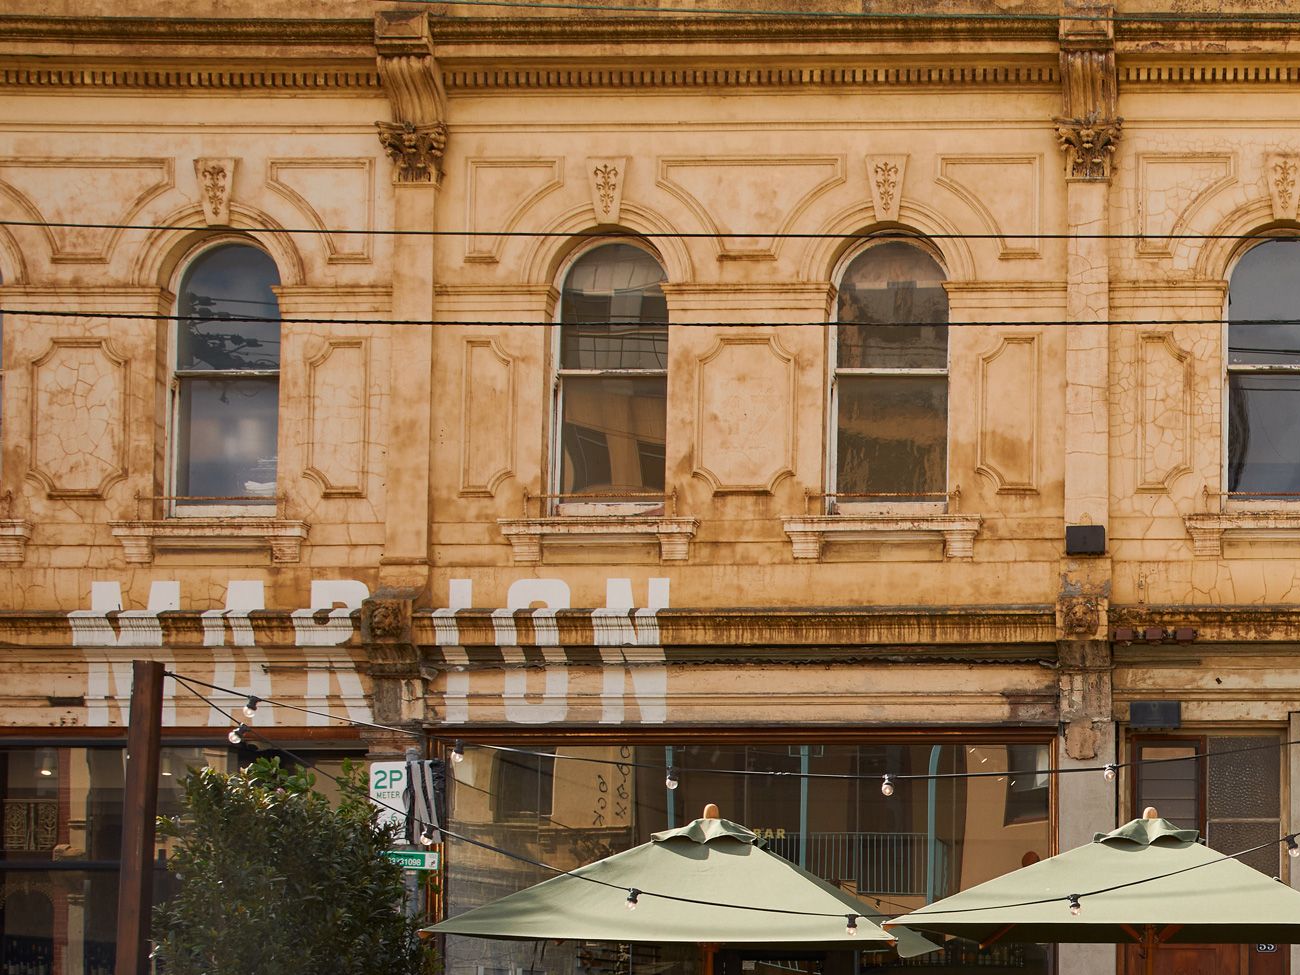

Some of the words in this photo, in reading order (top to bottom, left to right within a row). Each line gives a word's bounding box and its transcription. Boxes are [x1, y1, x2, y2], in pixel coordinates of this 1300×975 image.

[67, 578, 671, 728] MARION
[374, 769, 404, 790] 2P
[376, 791, 401, 799] METER
[753, 828, 786, 839] BAR
